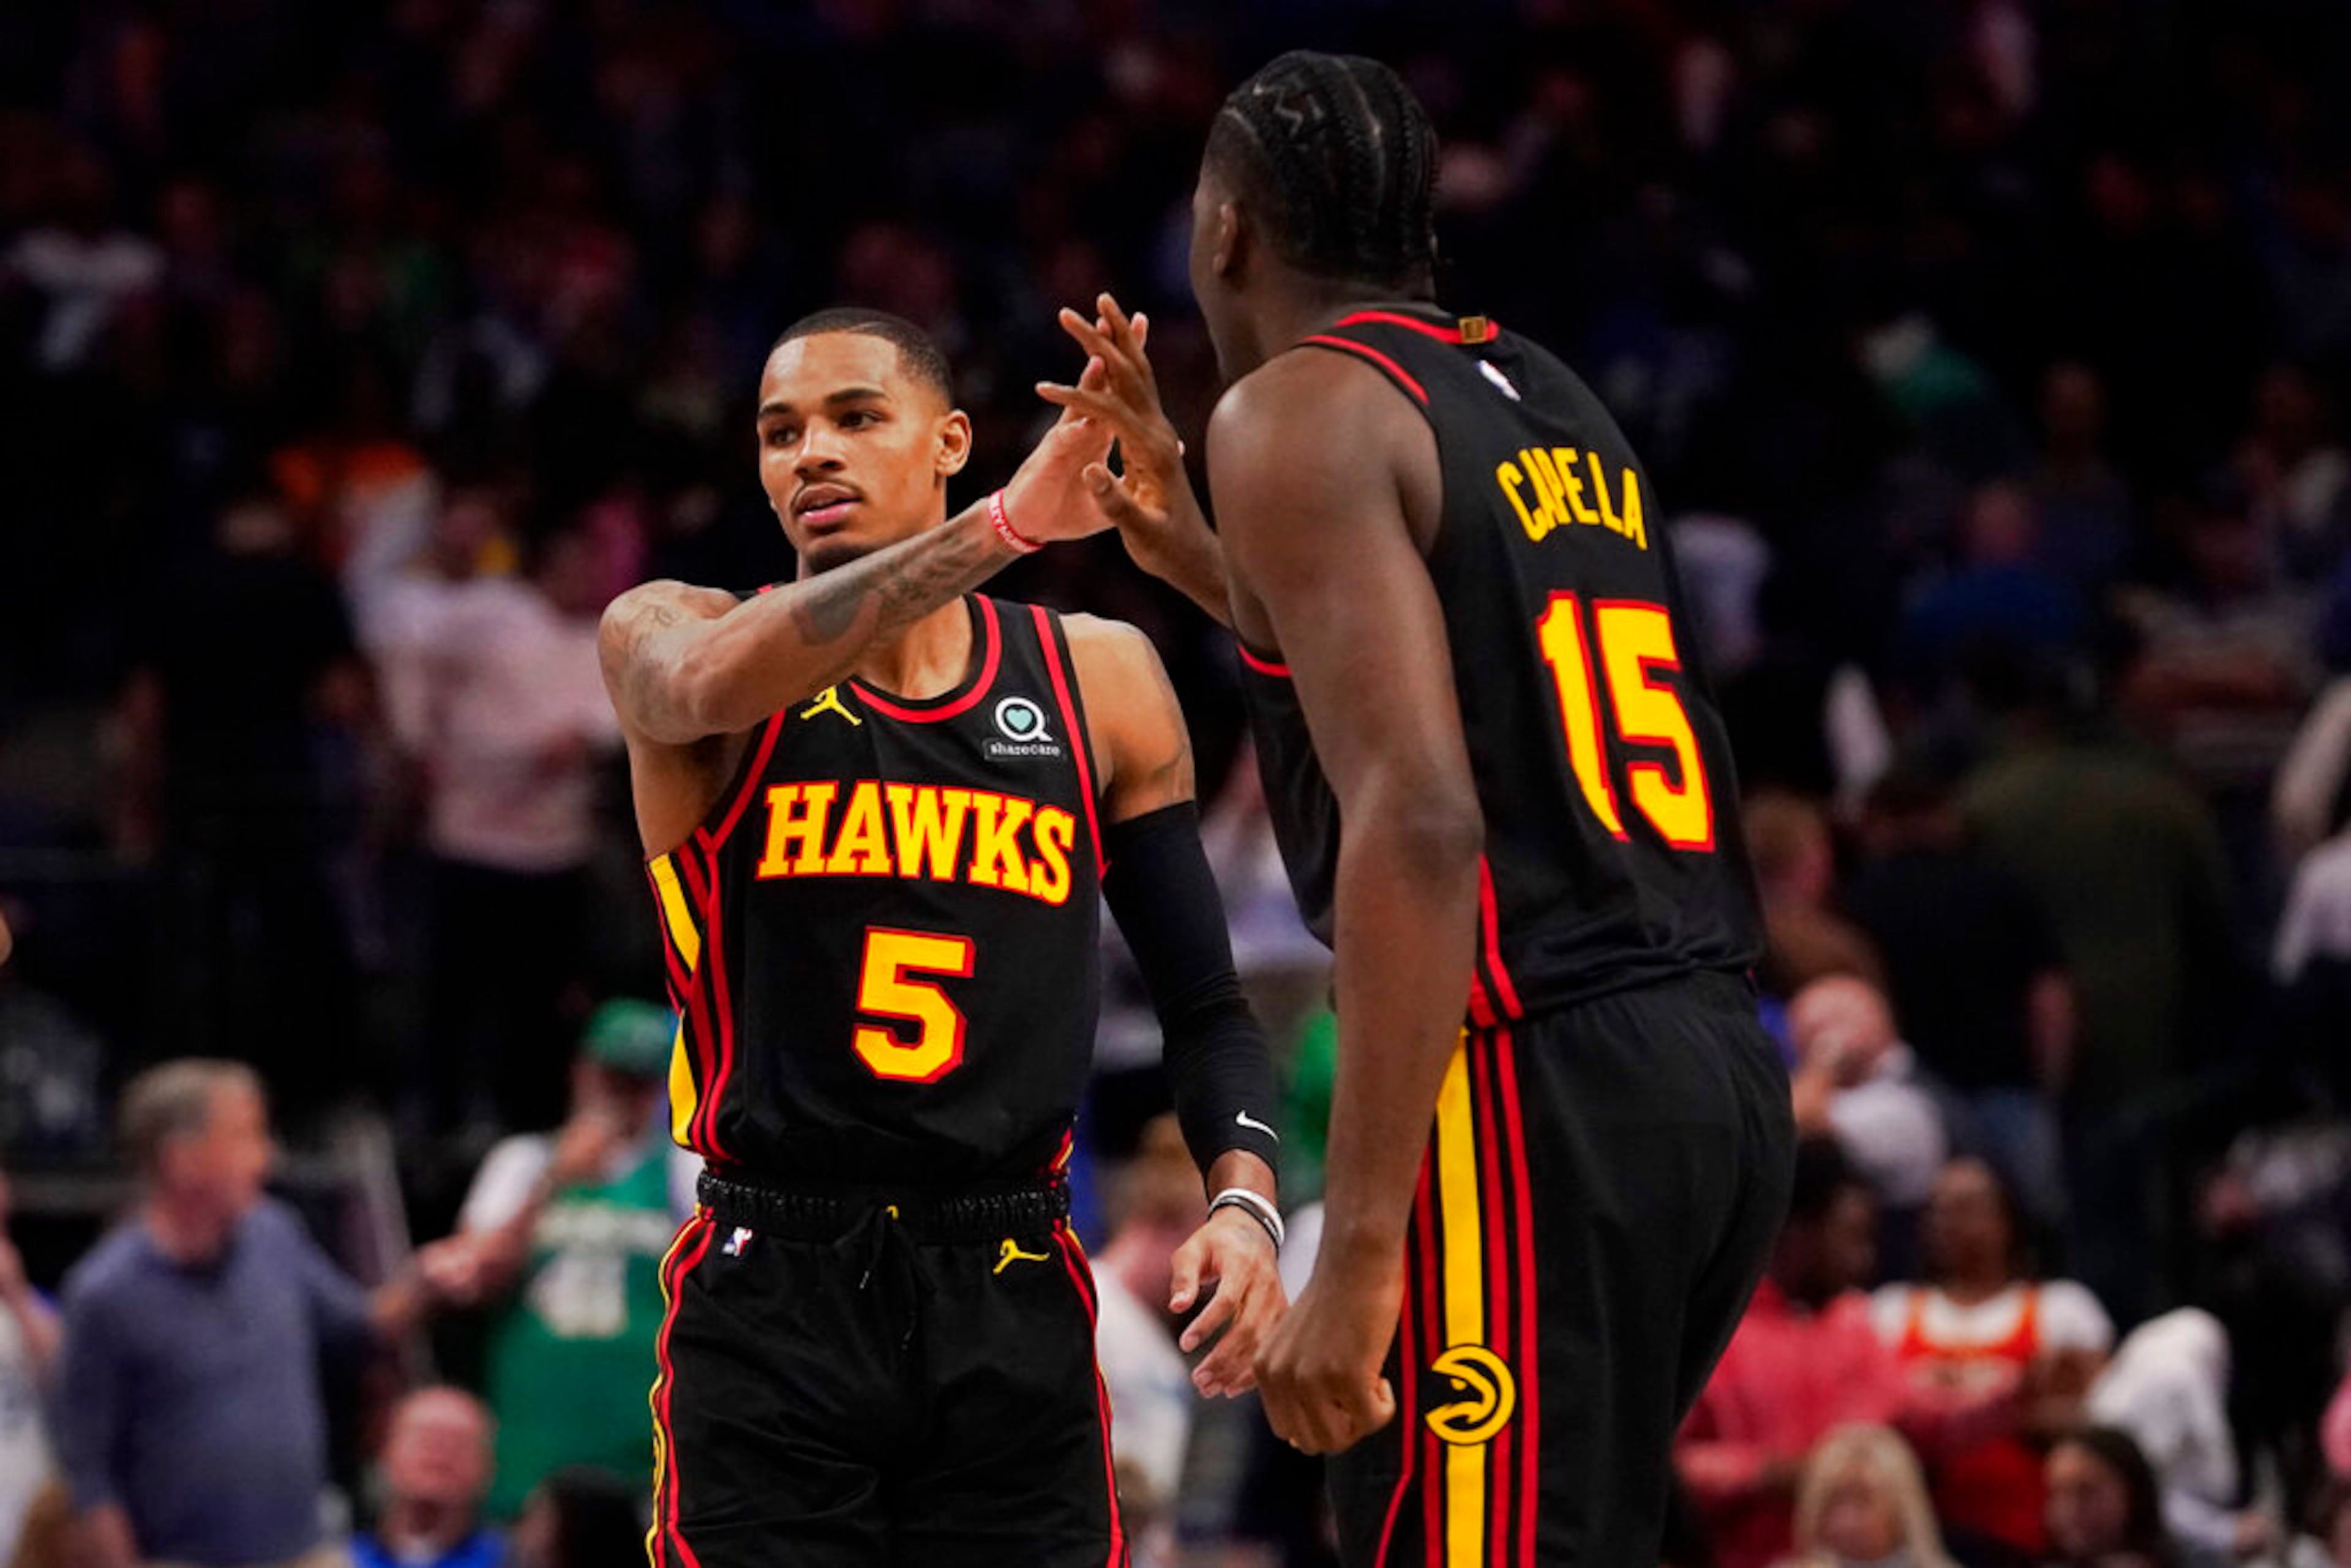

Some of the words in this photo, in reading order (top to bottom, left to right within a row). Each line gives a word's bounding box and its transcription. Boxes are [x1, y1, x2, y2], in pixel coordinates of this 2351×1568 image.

[1496, 446, 1648, 550] CAPELA
[989, 742, 1061, 757] sharecare
[1535, 589, 1715, 851] 15
[755, 778, 1076, 906] HAWKS
[852, 925, 976, 1083] 5
